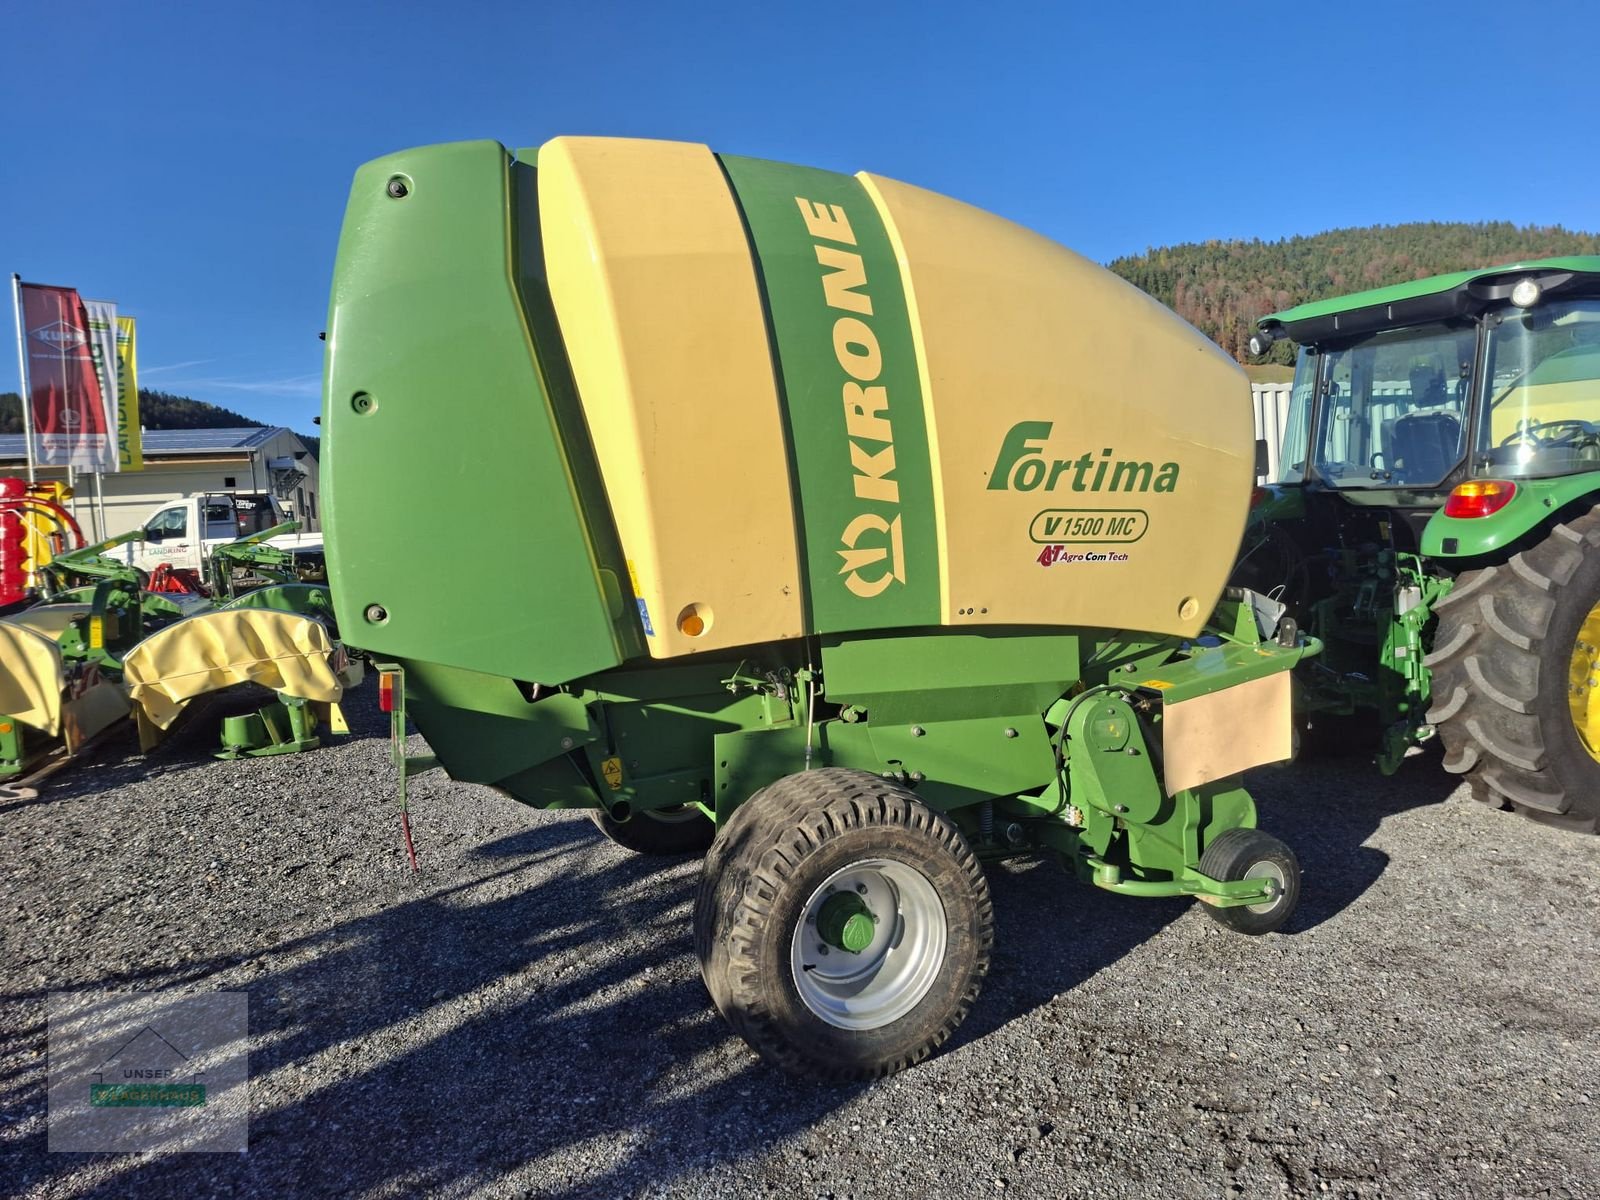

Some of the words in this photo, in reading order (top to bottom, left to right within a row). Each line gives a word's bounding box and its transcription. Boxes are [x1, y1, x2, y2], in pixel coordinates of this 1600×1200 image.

[794, 196, 900, 503] KRONE
[986, 420, 1180, 493] Fortima
[1044, 517, 1063, 536] V
[1063, 517, 1104, 536] 1500
[1105, 517, 1136, 536] MC
[1060, 552, 1084, 563] Agro
[1085, 552, 1107, 561] Com
[1108, 552, 1129, 561] Tech
